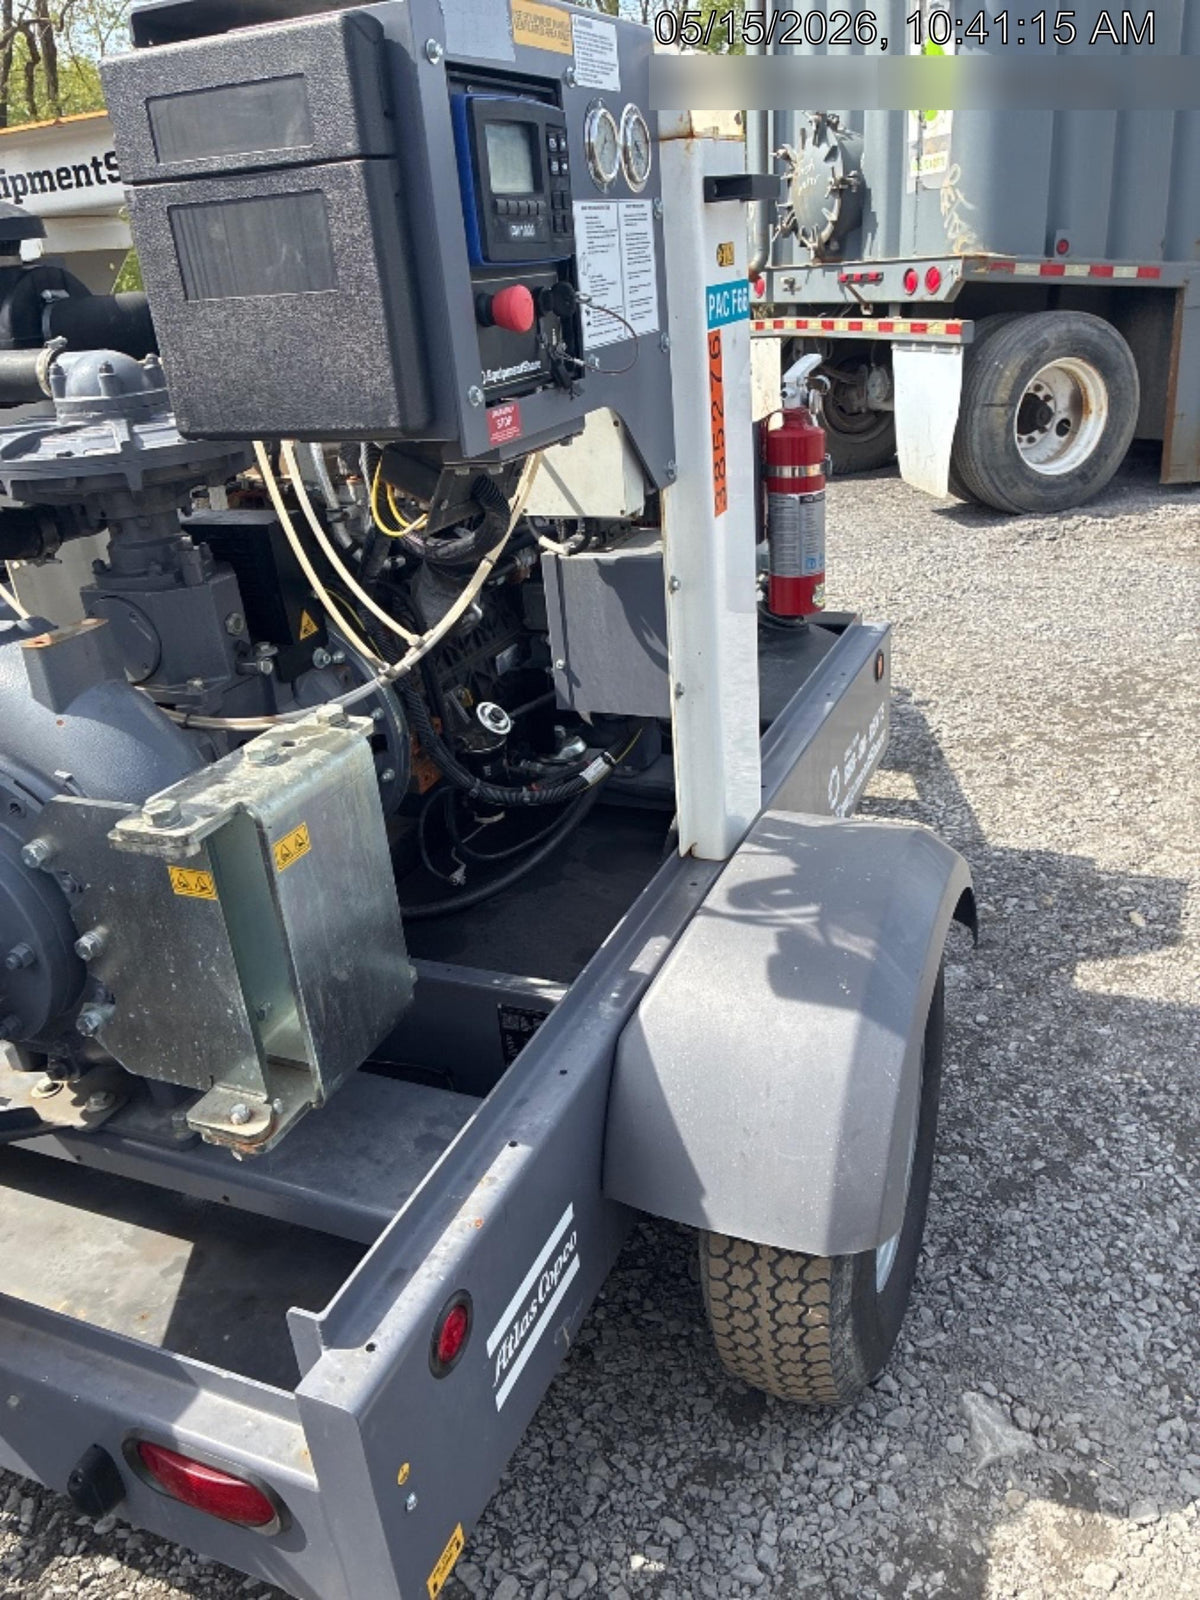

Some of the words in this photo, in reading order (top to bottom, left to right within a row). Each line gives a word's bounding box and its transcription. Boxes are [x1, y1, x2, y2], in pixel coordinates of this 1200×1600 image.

[708, 291, 729, 320] PAC
[709, 335, 726, 510] 385276
[492, 1298, 539, 1388] Atlas
[538, 1230, 577, 1304] Copco
